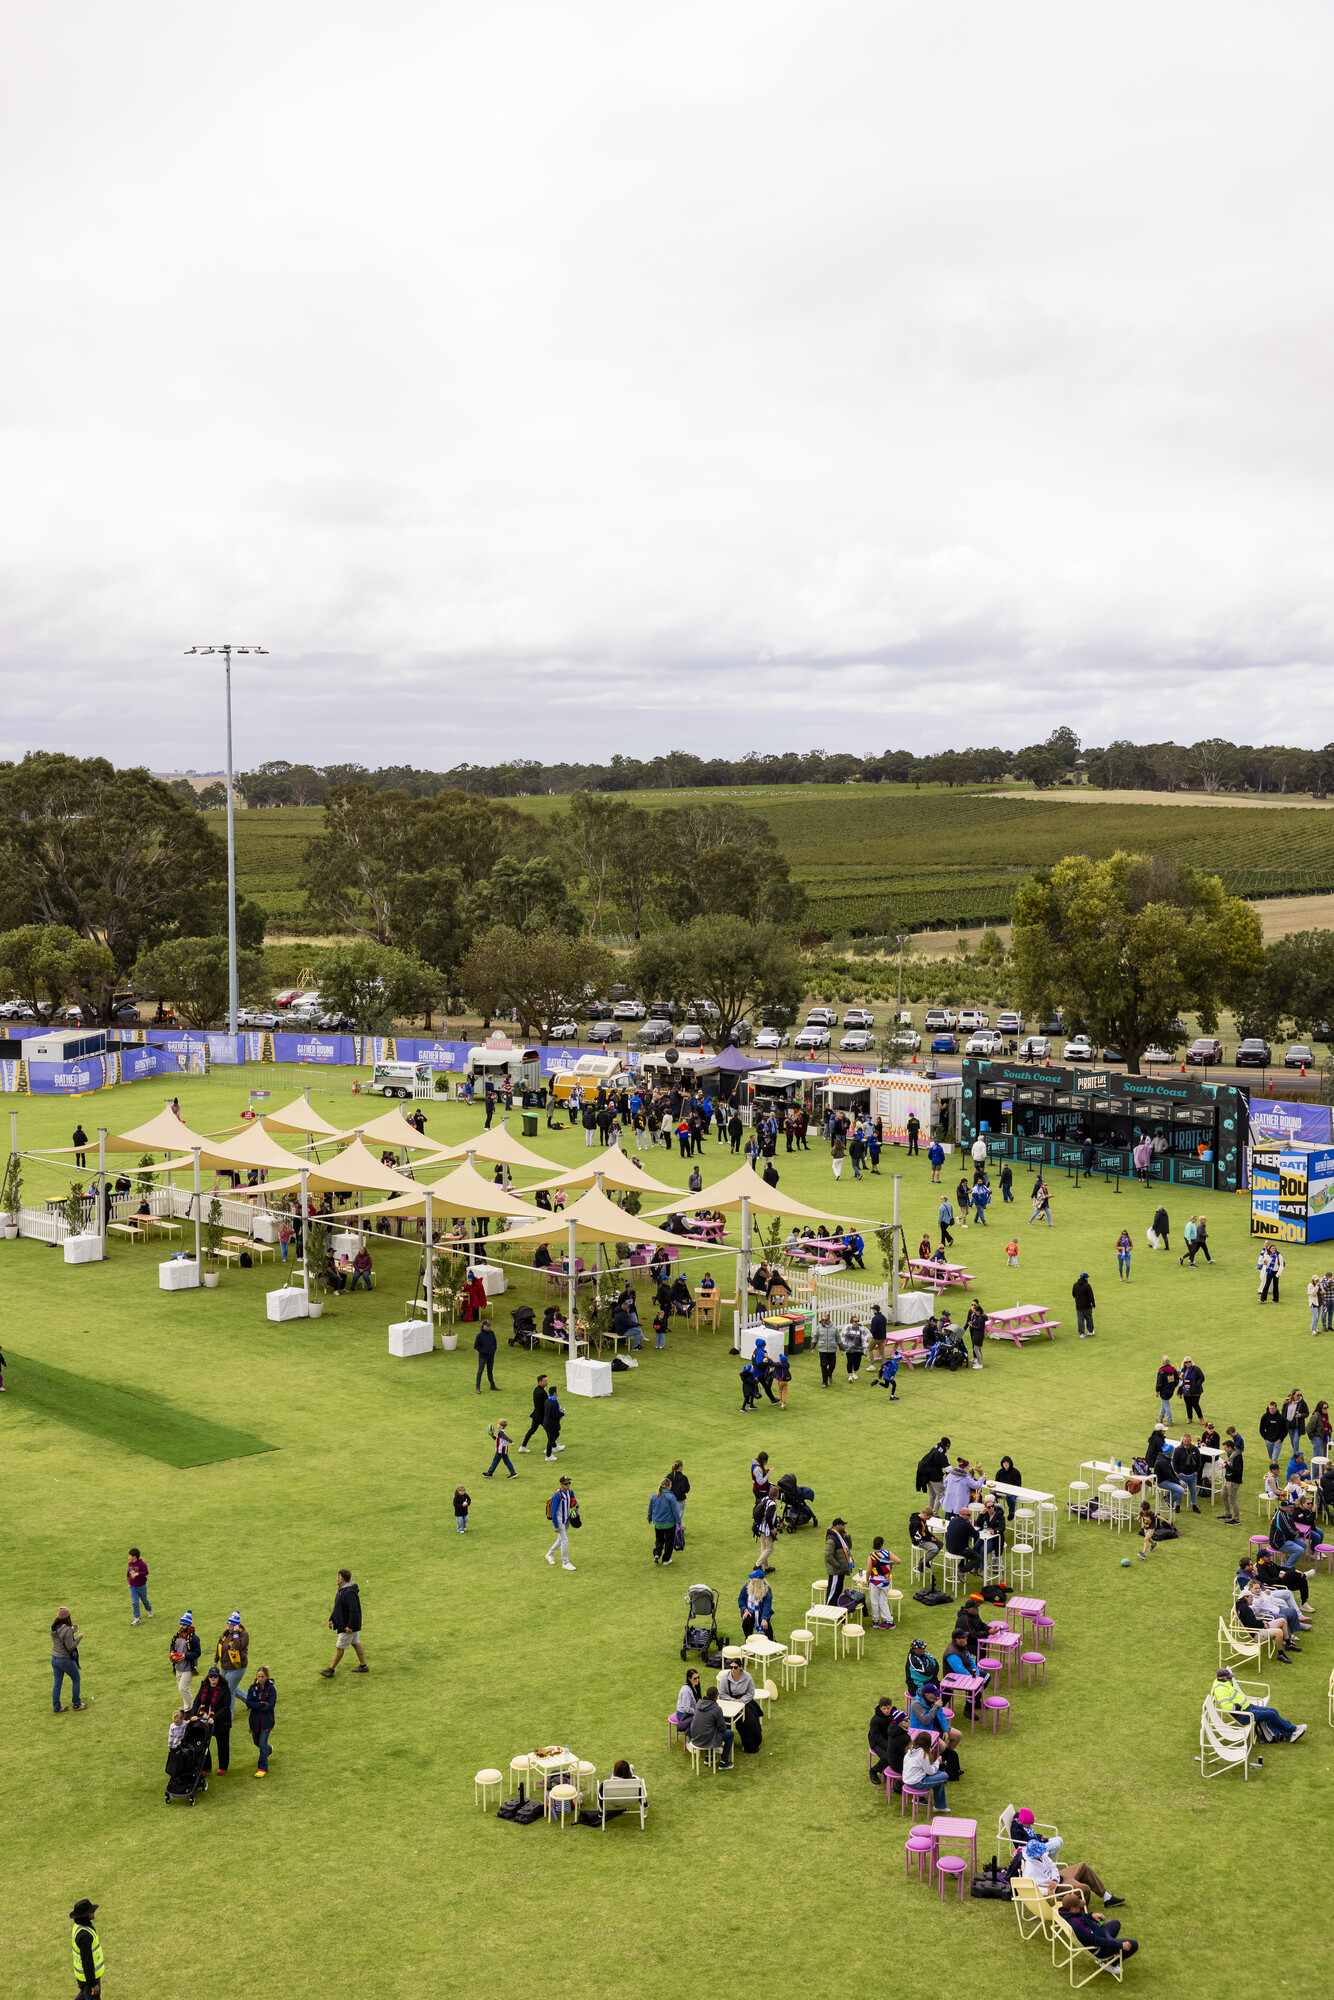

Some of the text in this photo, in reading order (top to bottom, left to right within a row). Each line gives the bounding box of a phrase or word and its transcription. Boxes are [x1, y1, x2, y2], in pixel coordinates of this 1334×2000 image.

[262, 1033, 272, 1062] ROUND
[297, 1044, 334, 1054] GATHER ROUND
[418, 1050, 455, 1061] GATHER ROUND
[16, 1061, 28, 1092] ROUND
[54, 1074, 78, 1084] GATHER
[1003, 1069, 1062, 1083] South Coast
[1123, 1082, 1188, 1098] South Coast
[1255, 1113, 1279, 1125] GATHER
[1280, 1116, 1302, 1128] ROUND
[1280, 1175, 1306, 1196] ROU
[1280, 1221, 1306, 1242] ROU
